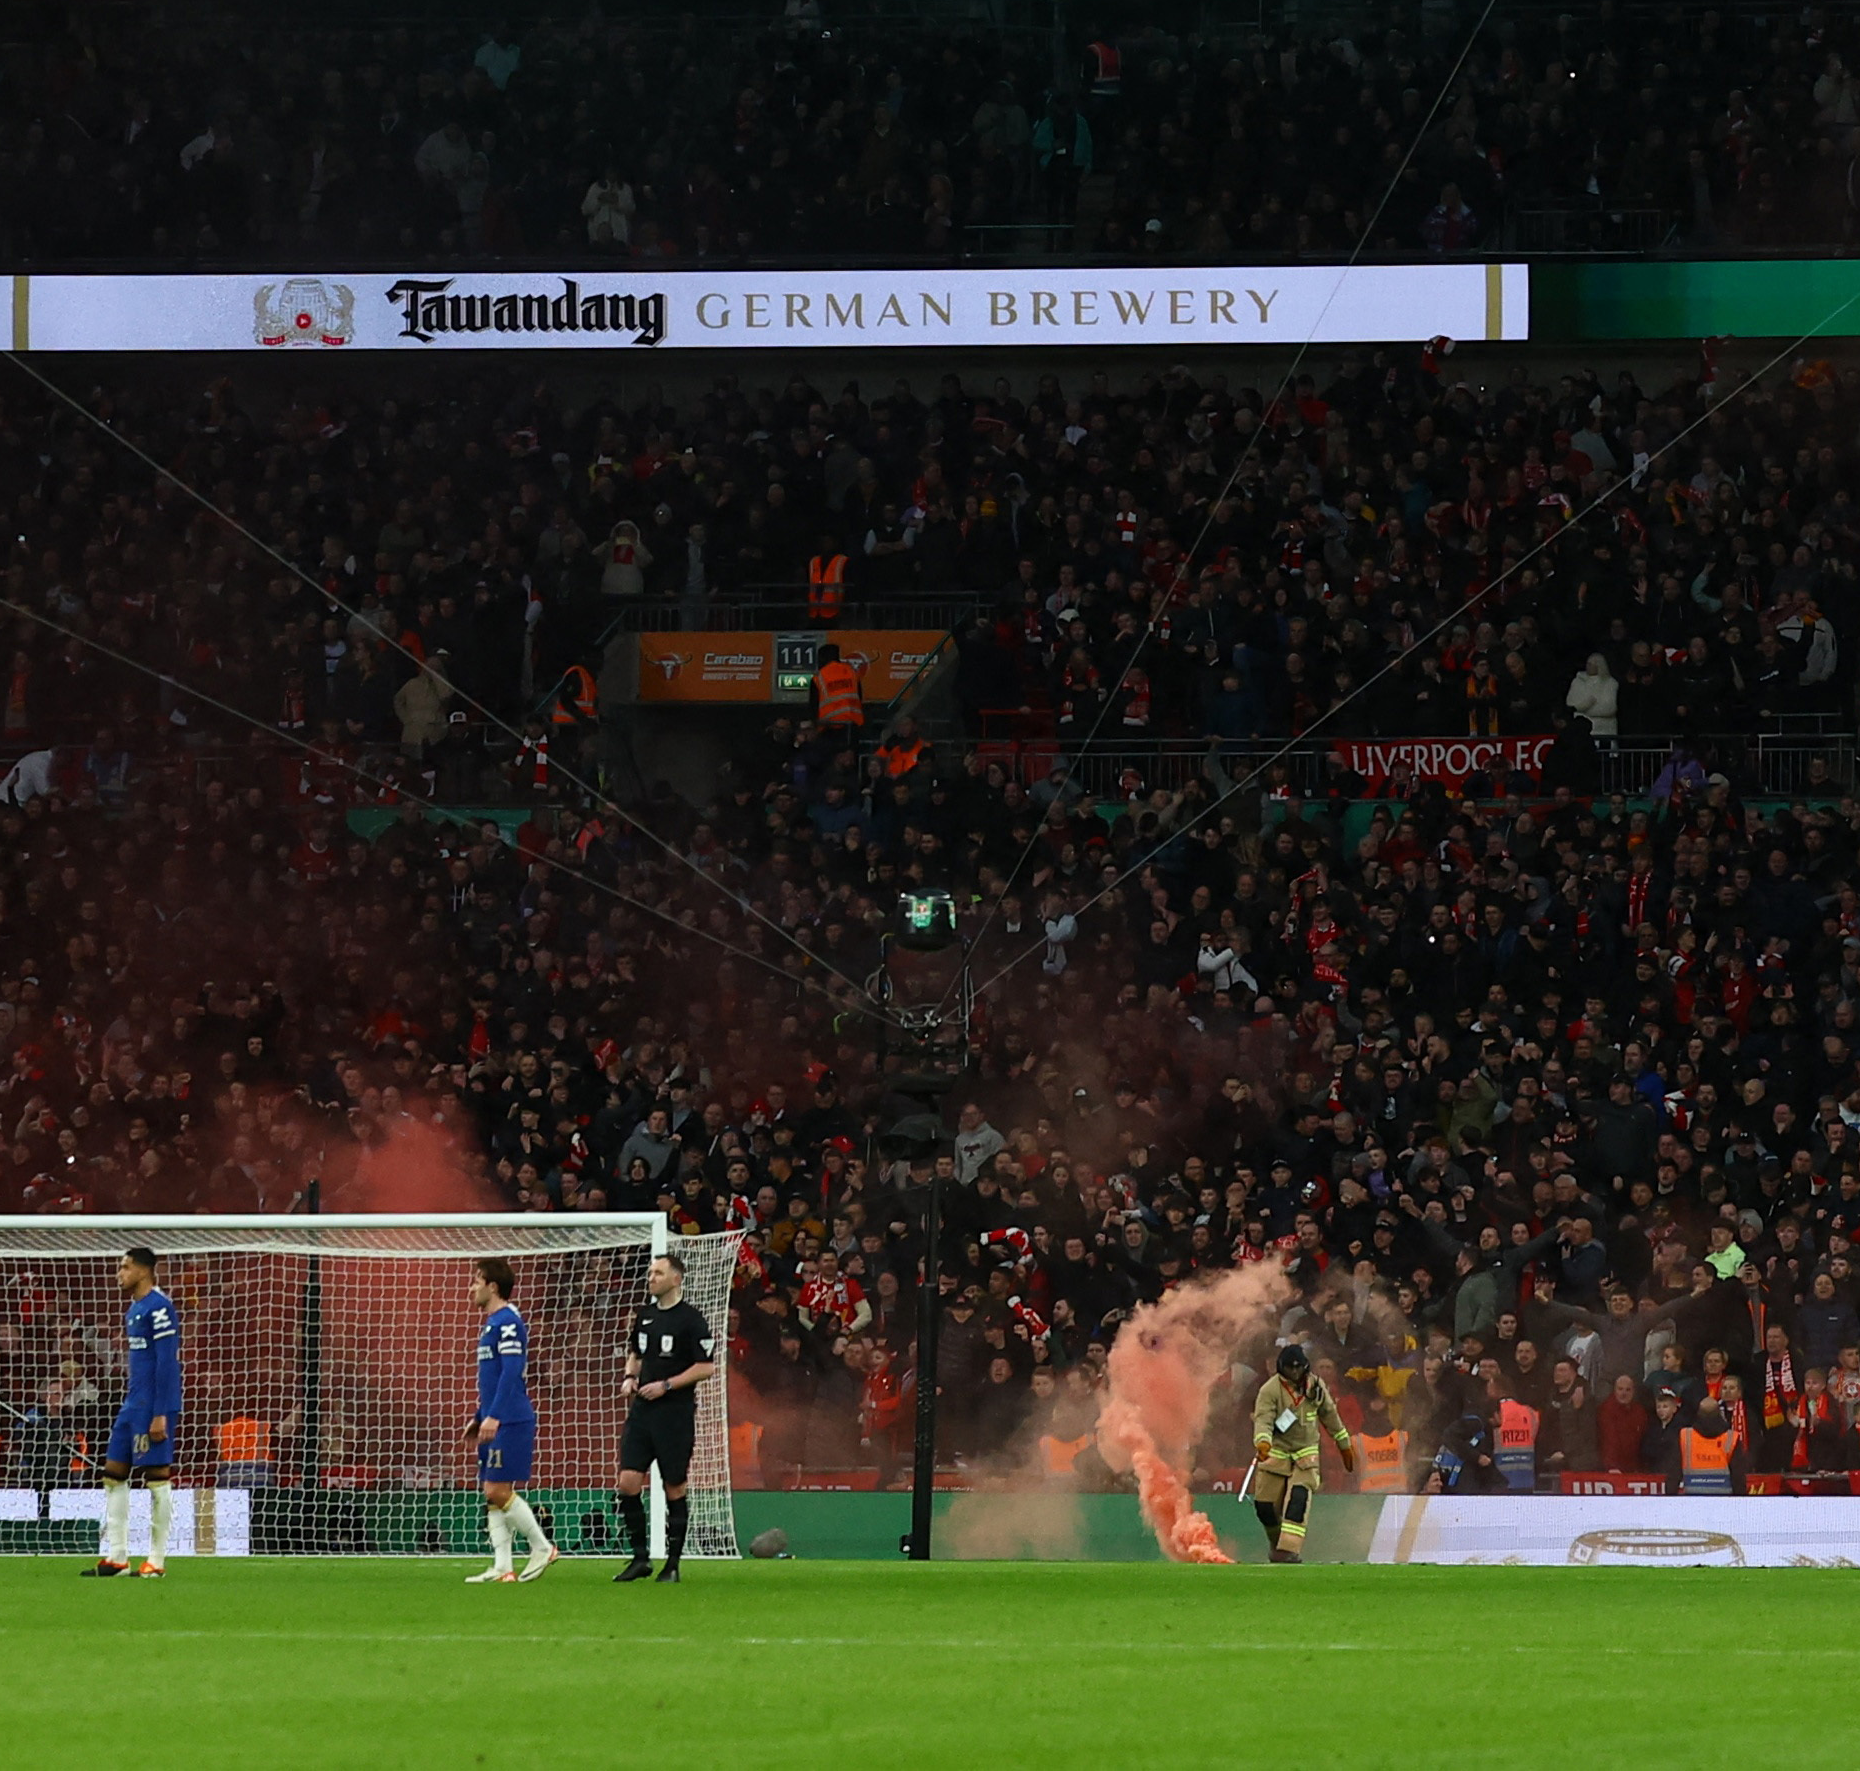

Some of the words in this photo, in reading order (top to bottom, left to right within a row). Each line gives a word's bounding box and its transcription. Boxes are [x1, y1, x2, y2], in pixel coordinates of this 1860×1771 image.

[383, 276, 669, 347] Tawandang
[695, 290, 953, 330] GERMAN
[987, 287, 1282, 328] BREWERY
[703, 653, 764, 667] Carabao
[780, 646, 814, 665] 111
